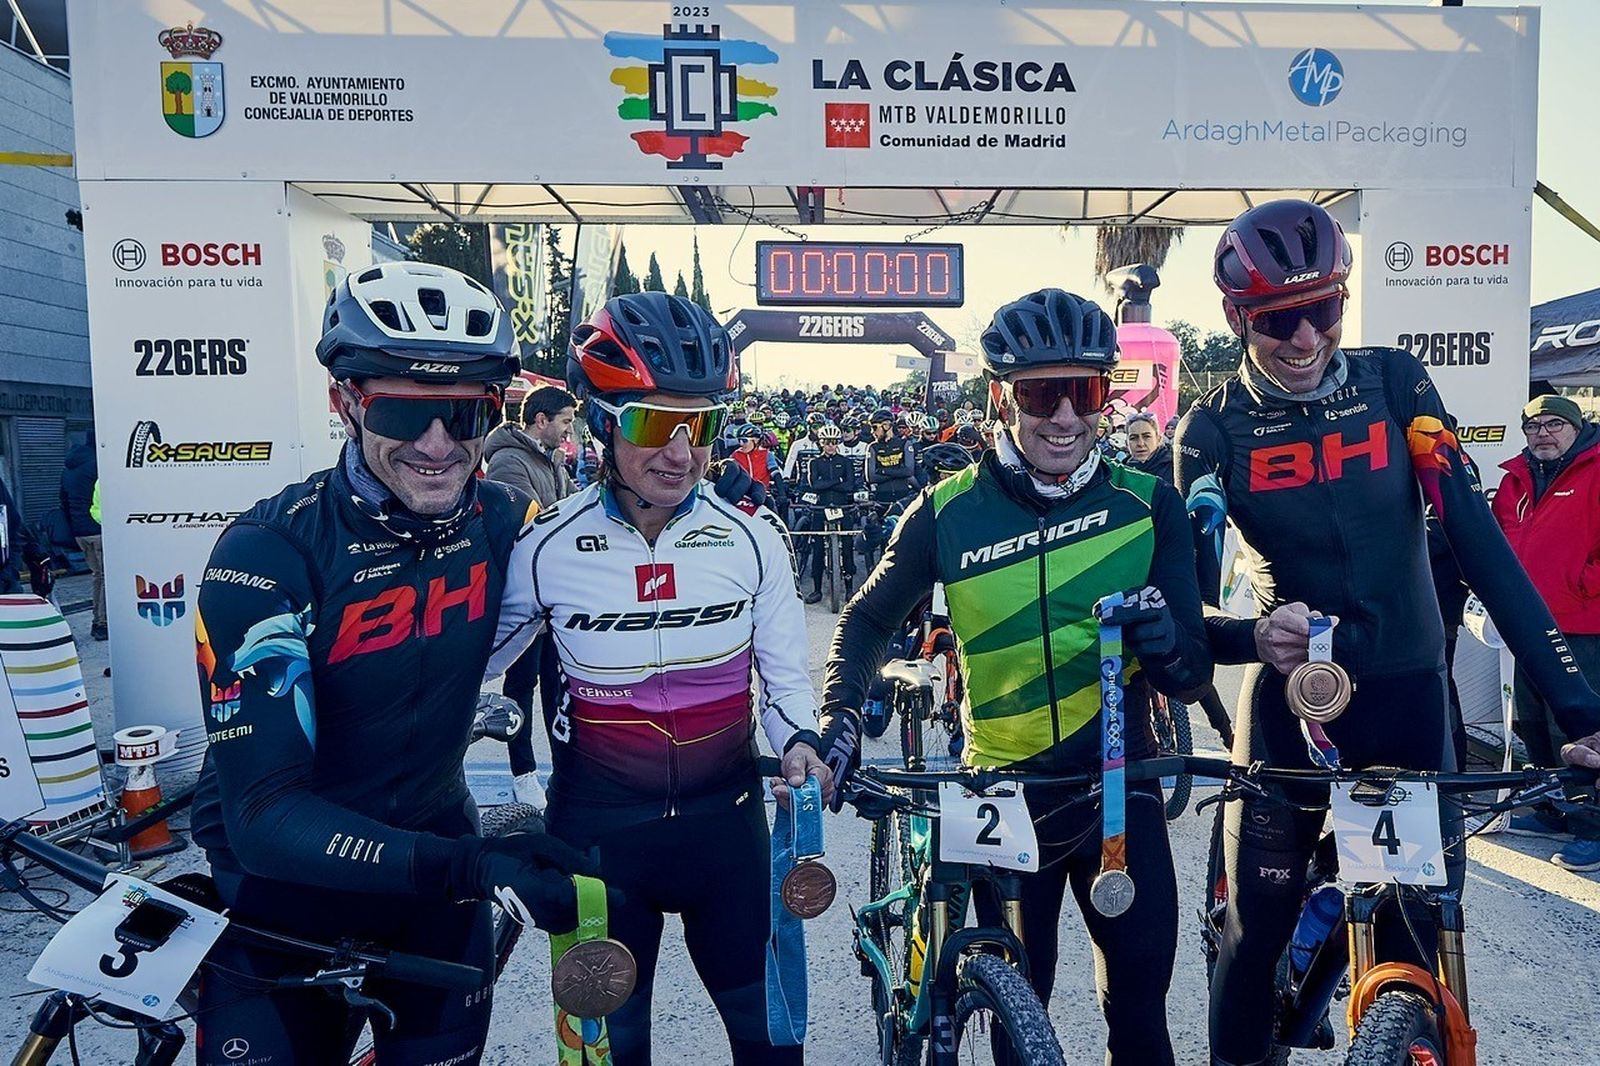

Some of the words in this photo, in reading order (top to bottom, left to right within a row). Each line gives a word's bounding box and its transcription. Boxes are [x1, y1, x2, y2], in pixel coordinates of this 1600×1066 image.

[673, 6, 710, 17] 2023
[250, 76, 300, 91] EXCMO.
[306, 77, 405, 92] AYUNTAMIENTO
[812, 59, 872, 90] LA
[883, 53, 1076, 93] CLÁSICA
[269, 92, 287, 105] DE
[289, 92, 388, 106] VALDEMORILLO
[244, 107, 325, 122] CONCEJALIA
[328, 109, 345, 122] DE
[348, 109, 414, 123] DEPORTES
[879, 106, 917, 124] MTB
[925, 106, 1067, 126] VALDEMORILLO
[879, 134, 971, 147] Comunidad
[977, 134, 999, 147] de
[1004, 134, 1066, 148] Madrid
[1162, 119, 1467, 147] ArdaghMetalPackaging
[161, 243, 262, 266] BOSCH
[1426, 244, 1509, 266] BOSCH
[115, 276, 183, 288] Innovación
[188, 278, 216, 290] para
[220, 278, 233, 288] tu
[237, 276, 263, 288] vida
[770, 251, 949, 295] 00:00:00
[1283, 270, 1321, 285] LAZER
[1385, 275, 1442, 287] Innovación
[1446, 278, 1470, 288] para
[1473, 277, 1484, 286] tu
[1487, 275, 1509, 286] vida
[799, 316, 865, 338] 226ERS
[134, 339, 248, 376] 226ERS
[1398, 332, 1491, 366] 226ERS
[409, 361, 460, 374] LAZER
[147, 441, 273, 462] X-SAUCE
[1248, 421, 1389, 494] BH
[674, 540, 735, 549] Gardenhotels
[960, 509, 1109, 570] MERIDA
[205, 567, 278, 591] CHAOYANG
[327, 560, 488, 665] BH
[1545, 627, 1579, 674] GOBIK
[1108, 670, 1117, 701] ATHENS
[119, 743, 159, 759] MTB
[975, 803, 1001, 846] 2
[1372, 810, 1401, 855] 4
[325, 833, 385, 864] GOBIK
[1259, 866, 1291, 880] FOX
